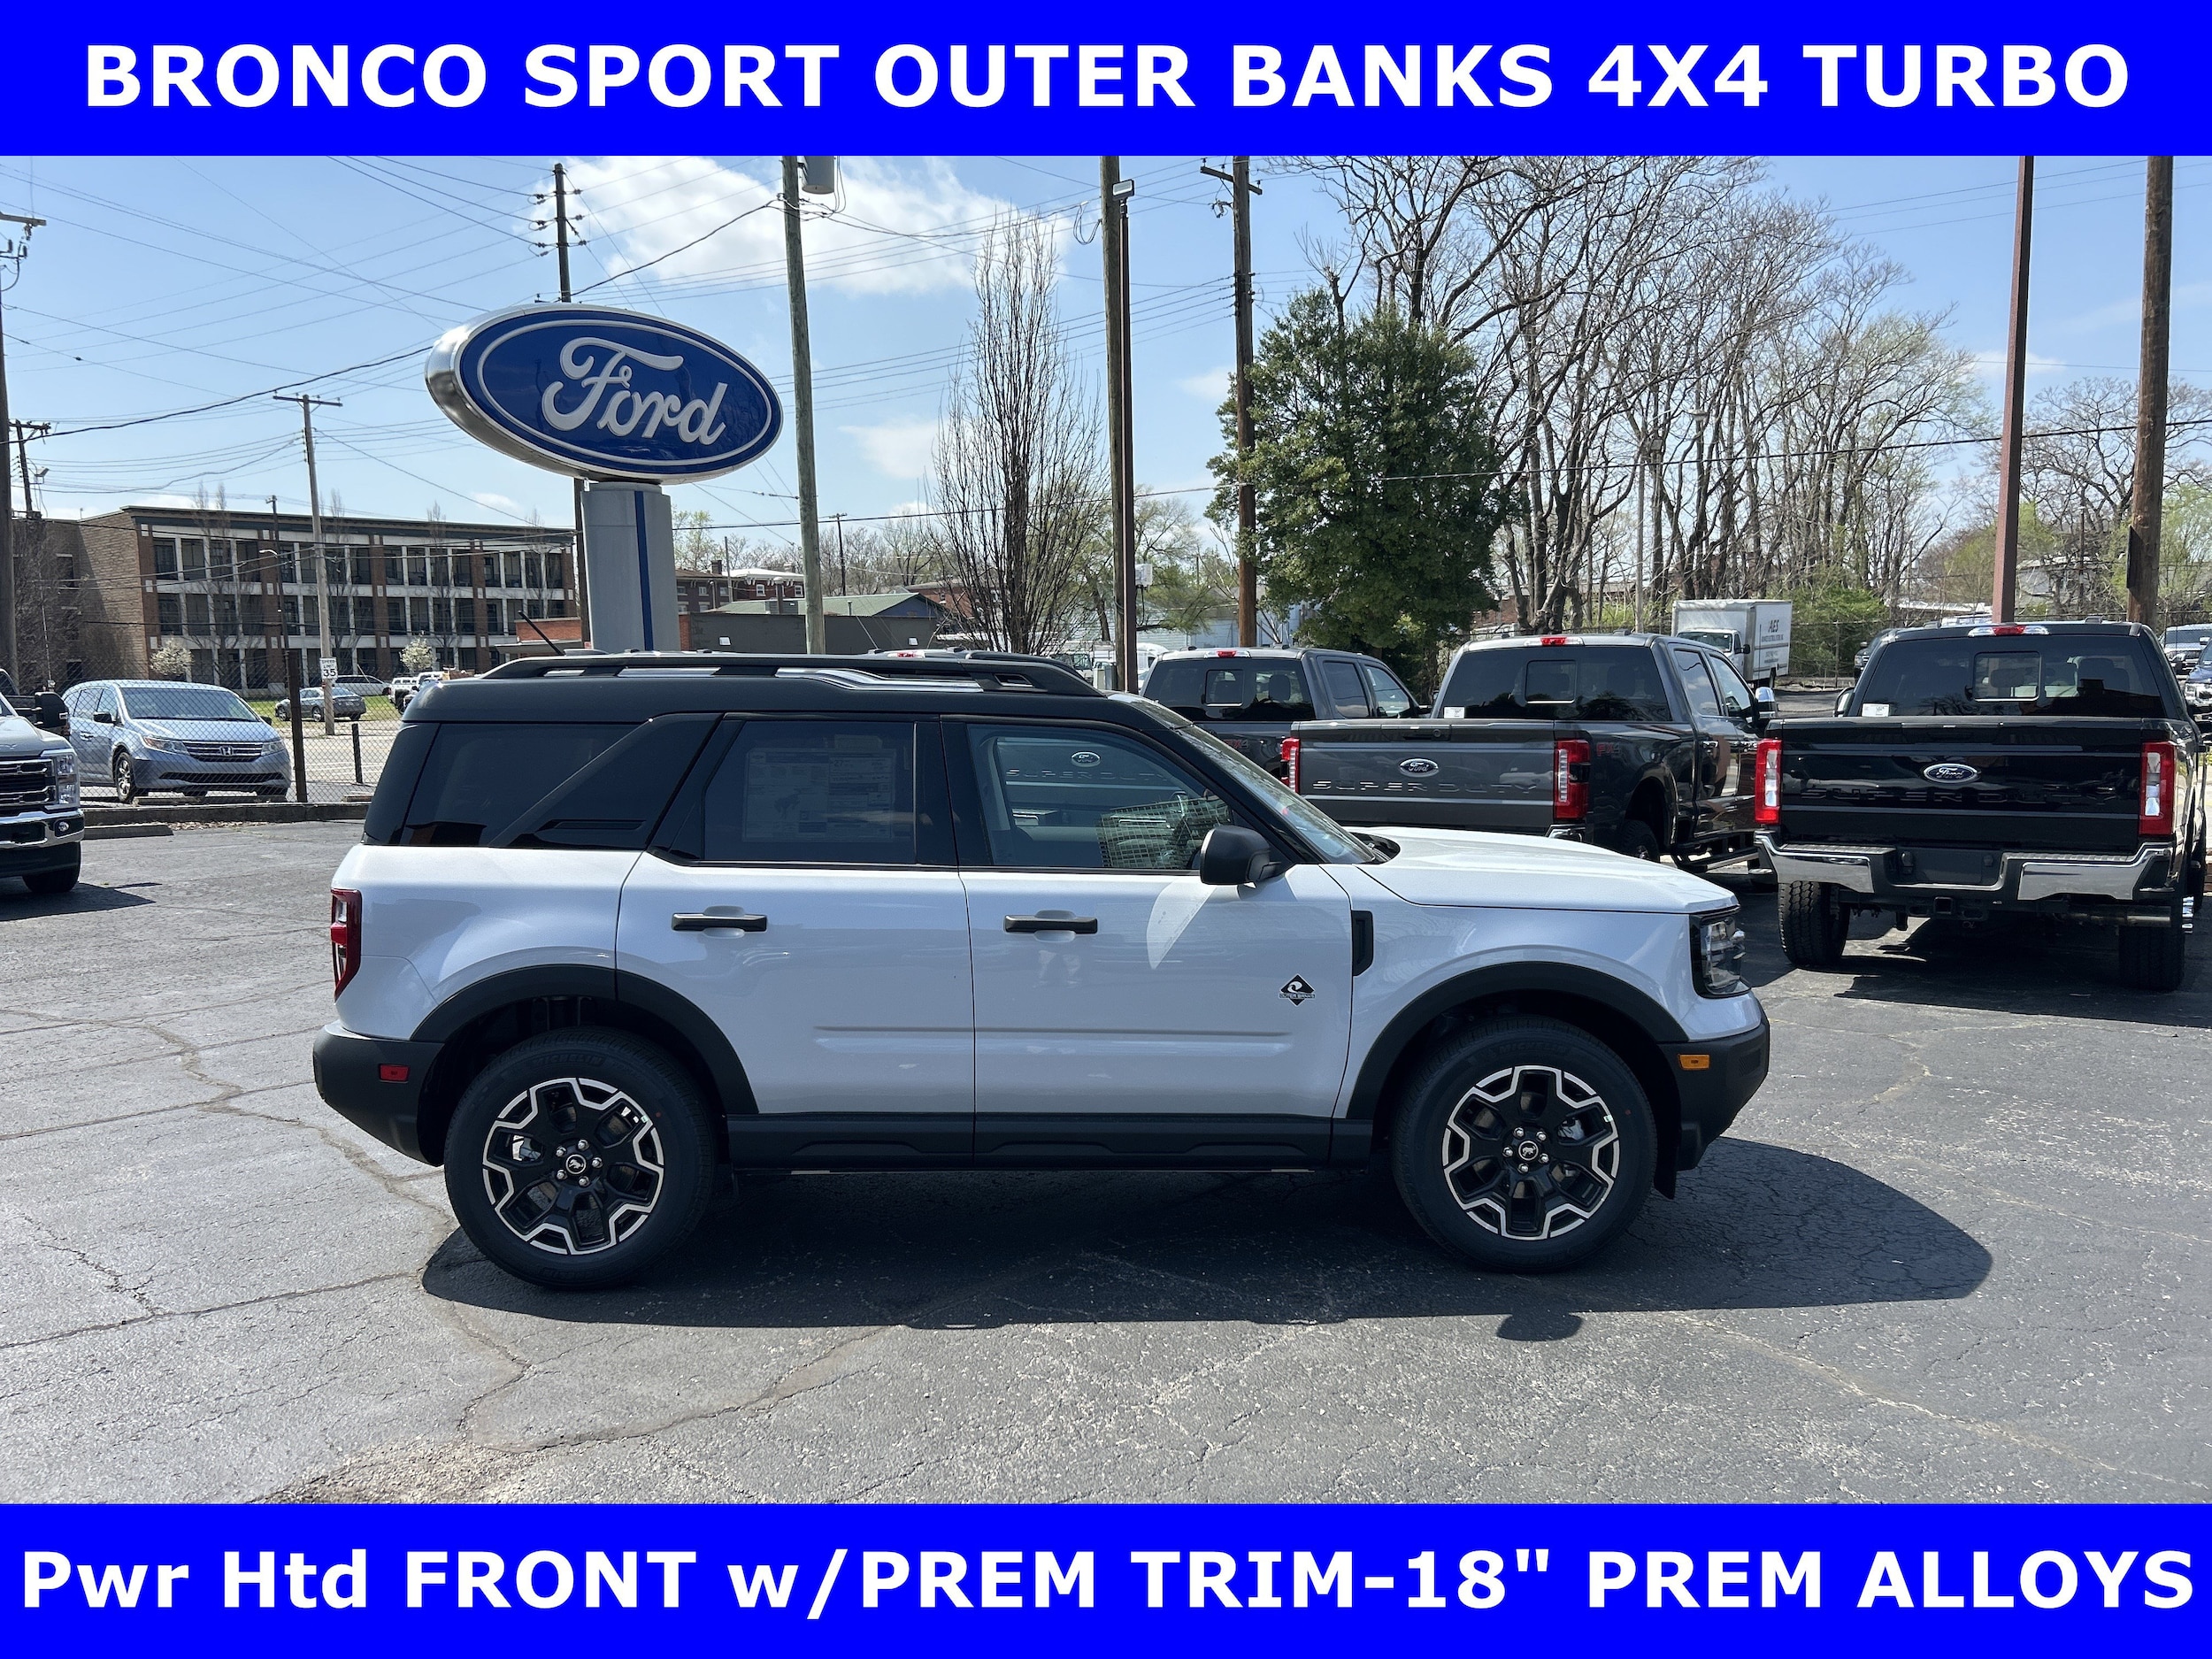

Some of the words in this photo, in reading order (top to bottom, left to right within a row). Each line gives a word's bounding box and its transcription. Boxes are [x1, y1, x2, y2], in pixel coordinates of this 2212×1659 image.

[541, 336, 728, 445] Ford
[1408, 761, 1430, 772] Ford
[1936, 766, 1965, 779] Ford
[1312, 780, 1428, 792] SUPER
